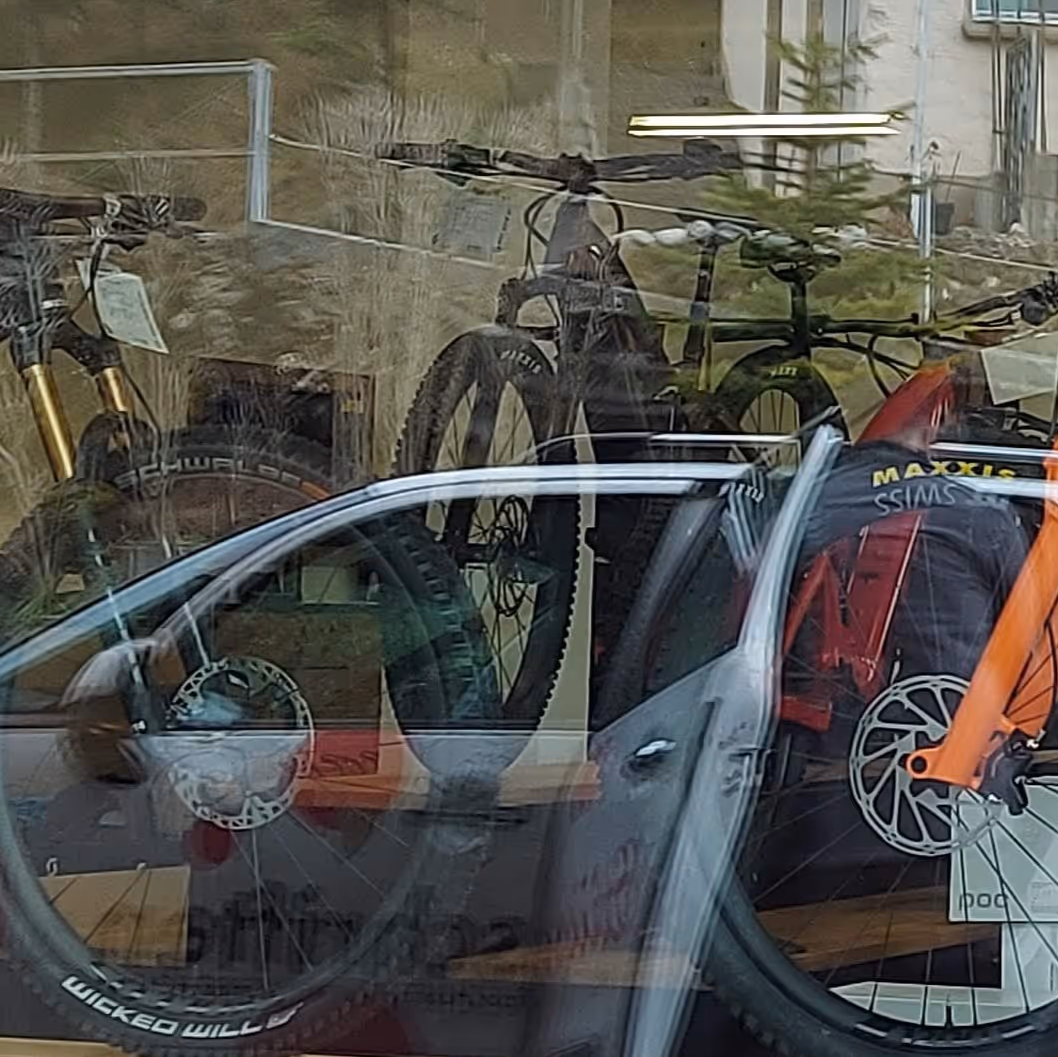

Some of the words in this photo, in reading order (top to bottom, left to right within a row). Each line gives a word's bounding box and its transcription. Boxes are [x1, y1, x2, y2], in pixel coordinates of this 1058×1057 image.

[871, 461, 1016, 488] MAXXIS
[62, 975, 179, 1037] WICKED
[182, 1015, 263, 1039] WILL
